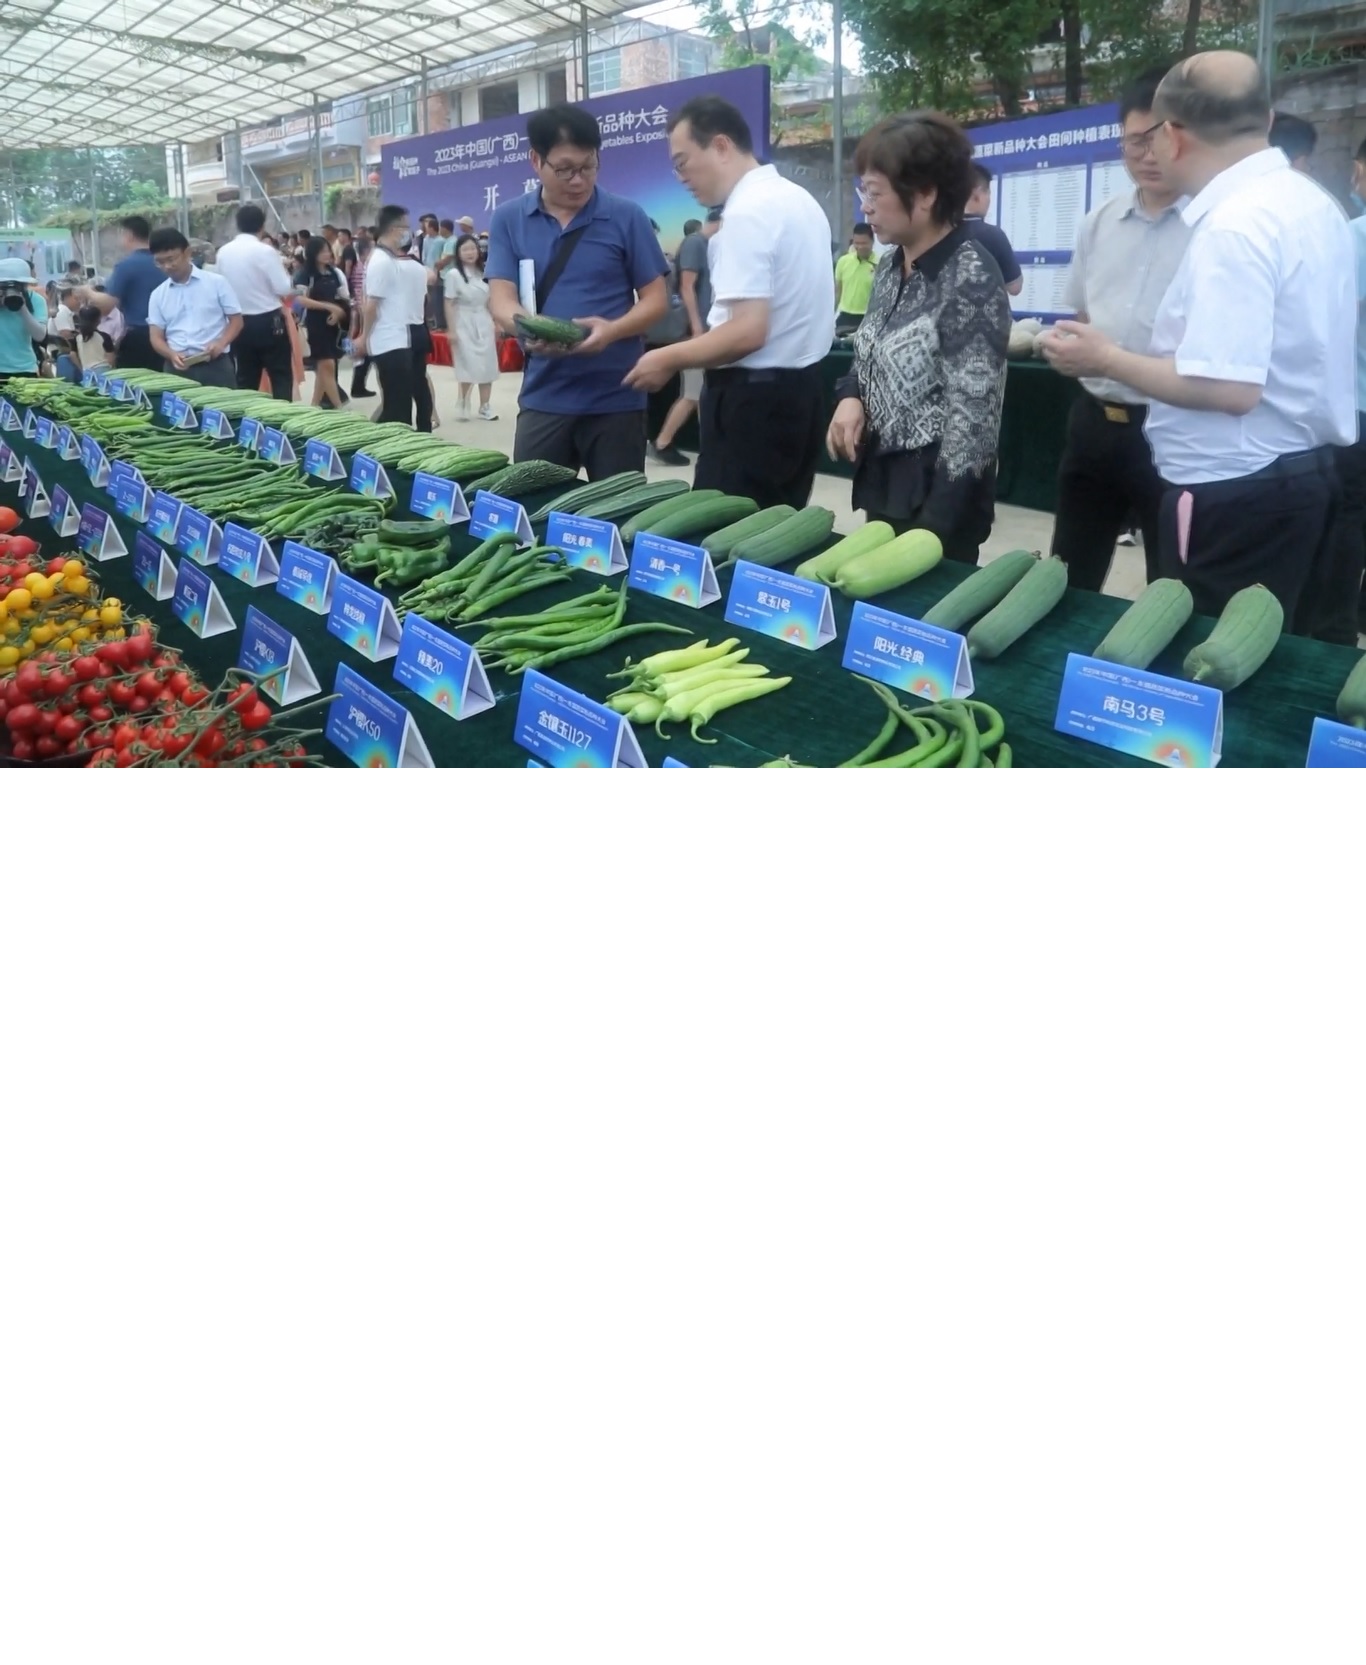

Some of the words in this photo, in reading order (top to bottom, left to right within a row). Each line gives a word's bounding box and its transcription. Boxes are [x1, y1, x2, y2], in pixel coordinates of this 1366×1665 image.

[503, 152, 528, 164] ASEAN
[1103, 695, 1166, 727] 南马3号
